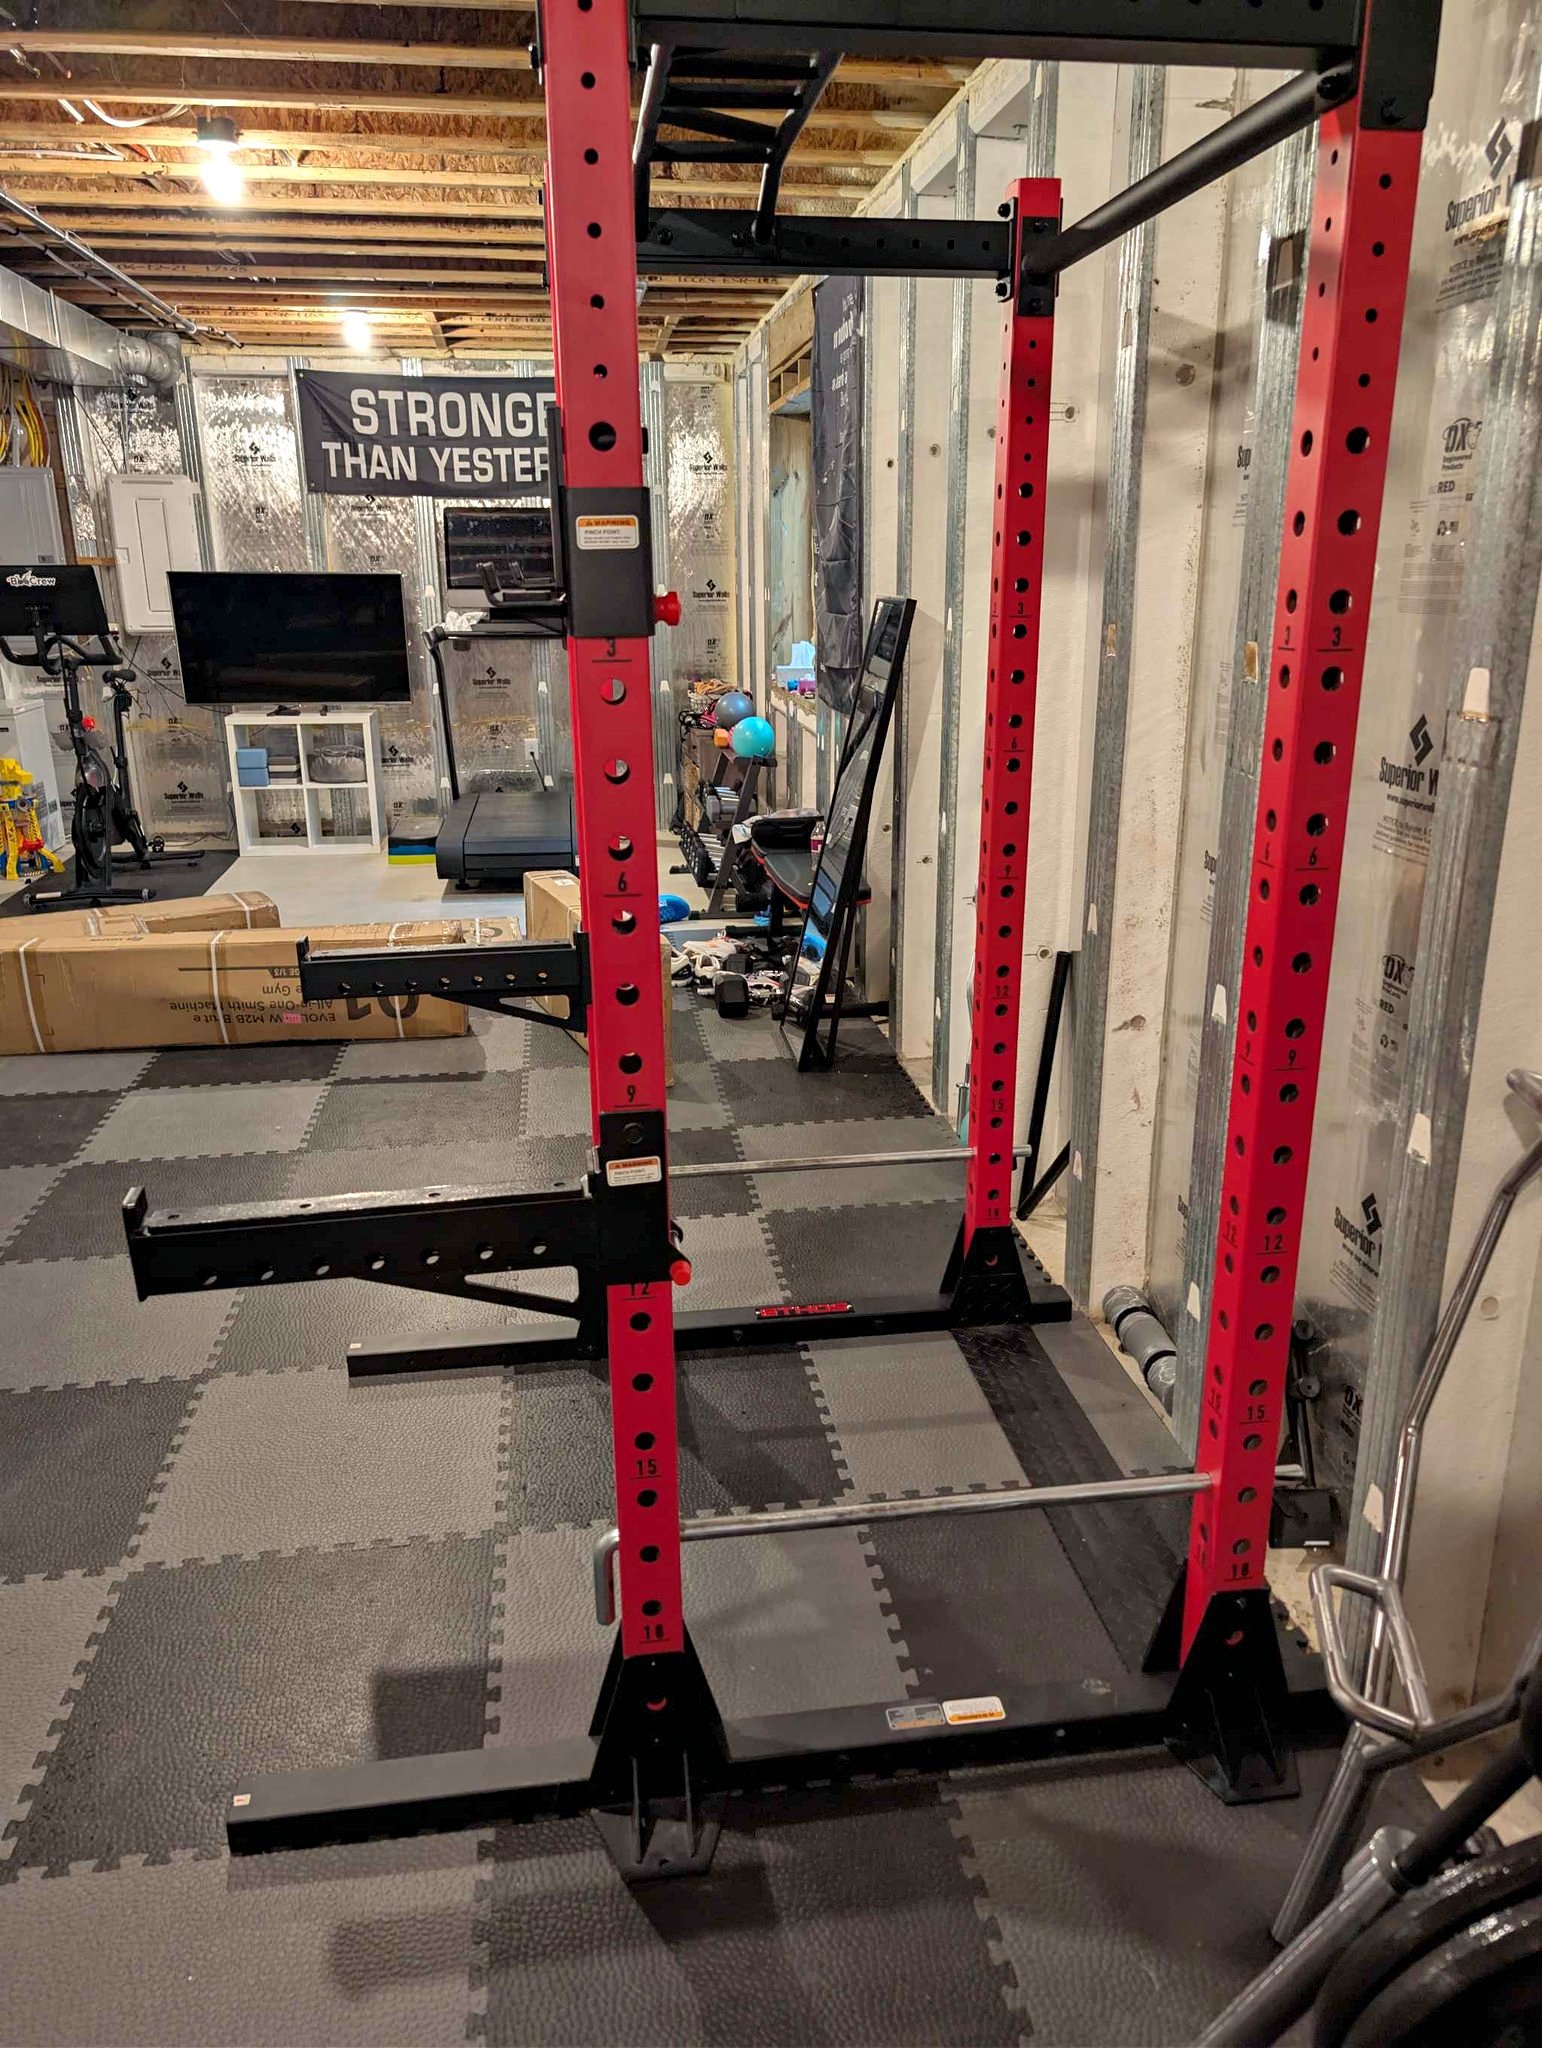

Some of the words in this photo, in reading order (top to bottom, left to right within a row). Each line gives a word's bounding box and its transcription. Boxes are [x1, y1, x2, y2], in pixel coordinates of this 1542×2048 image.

[1445, 184, 1500, 232] Superior
[321, 441, 418, 482] THAN
[1332, 626, 1342, 647] 3
[606, 636, 617, 657] 3
[1379, 757, 1425, 793] Superior
[1308, 846, 1318, 866] 6
[618, 871, 627, 893] 6
[262, 983, 291, 996] Gym
[229, 999, 266, 1011] Smith
[236, 1012, 265, 1024] M2B
[1288, 1049, 1297, 1067] 9
[626, 1085, 636, 1103] 9
[1334, 1206, 1376, 1259] Superior
[1264, 1234, 1283, 1251] 12
[630, 1281, 650, 1296] 12
[1247, 1404, 1265, 1421] 15
[636, 1459, 657, 1476] 15
[1231, 1562, 1250, 1578] 18
[643, 1623, 665, 1640] 18
